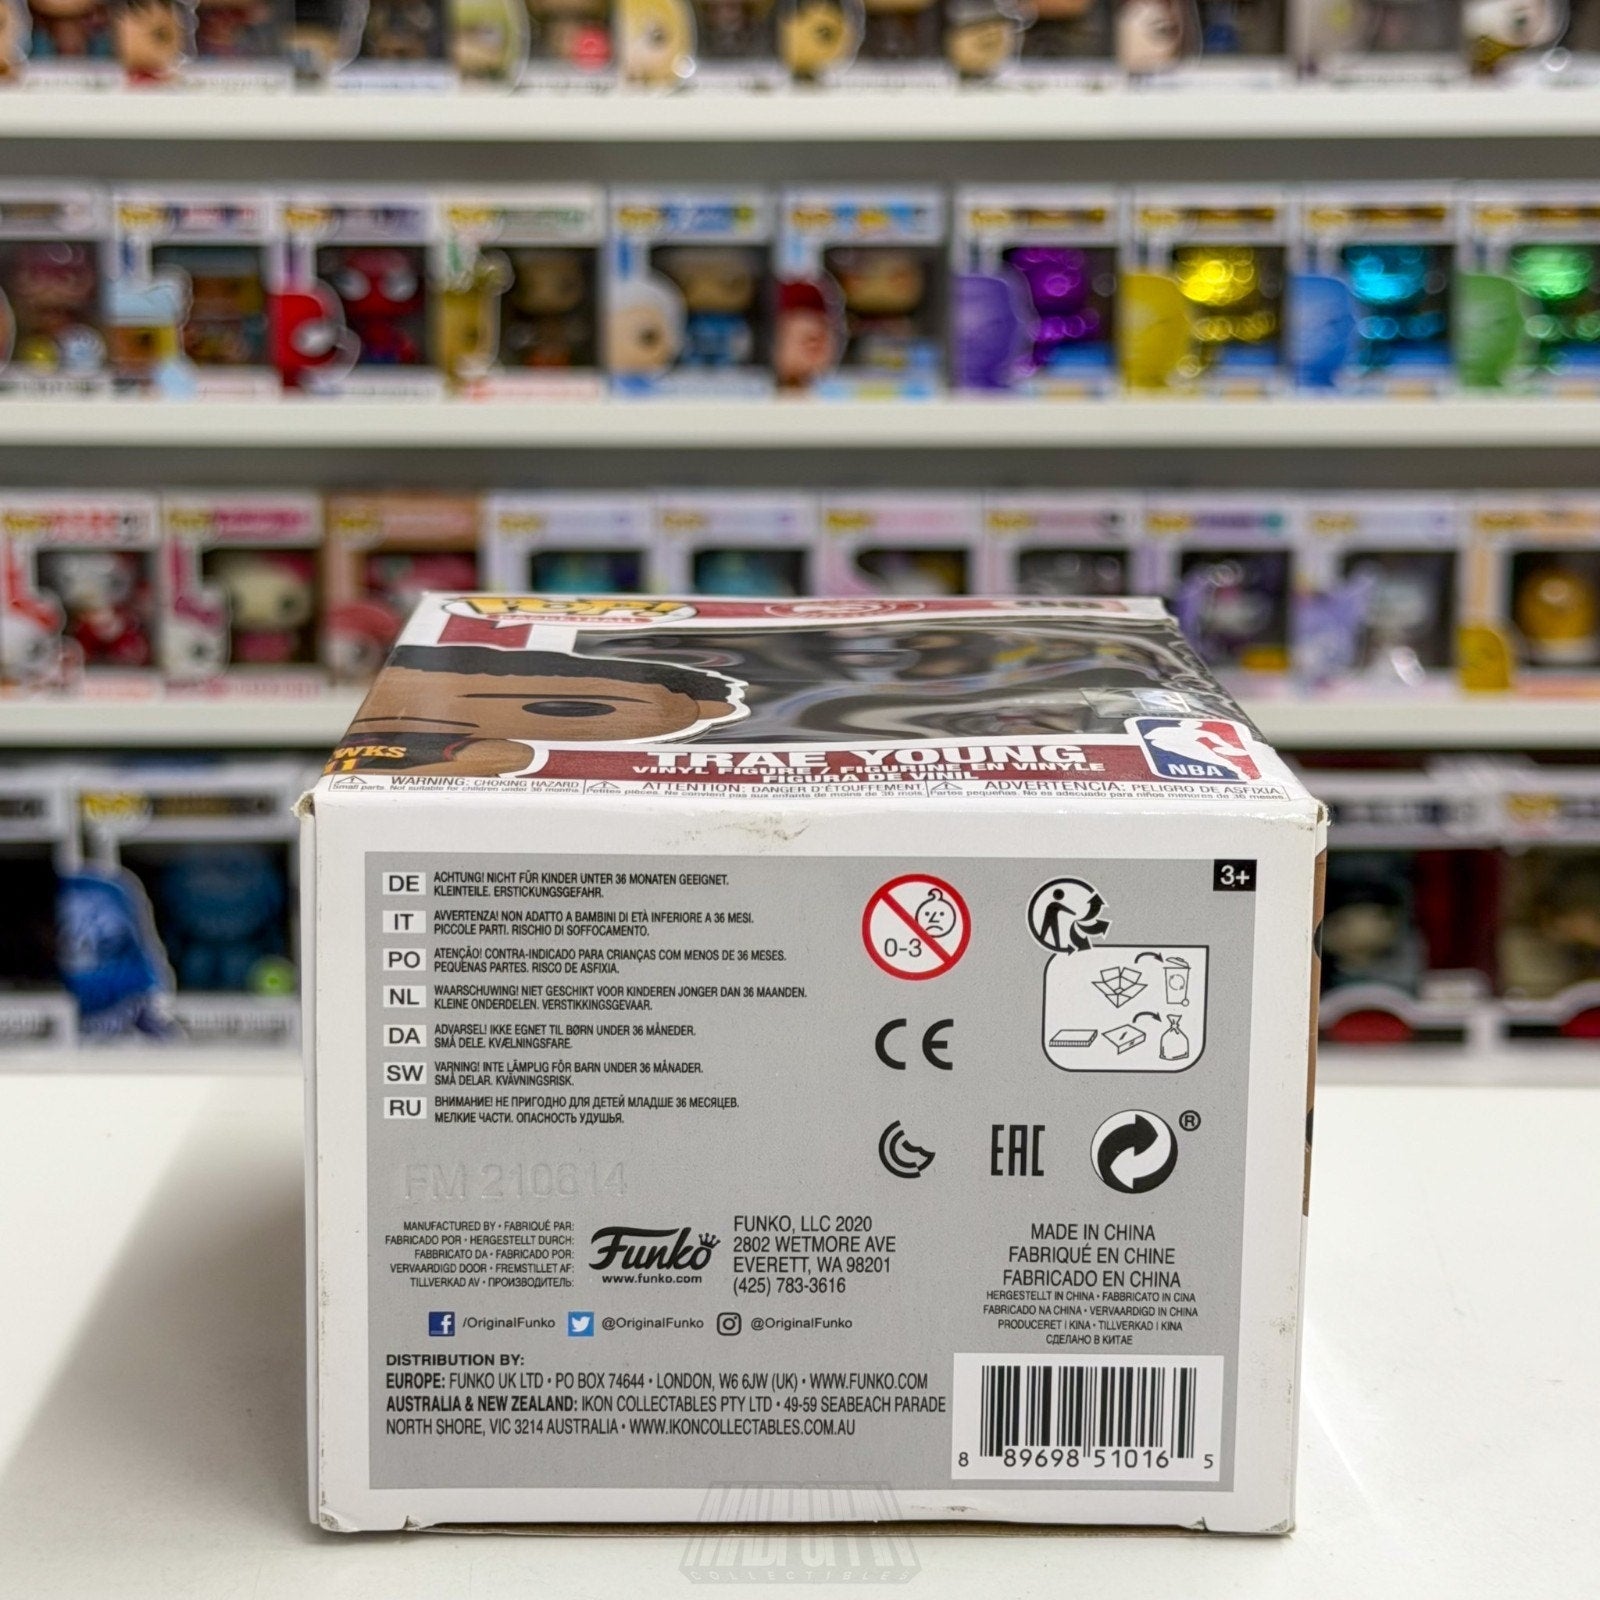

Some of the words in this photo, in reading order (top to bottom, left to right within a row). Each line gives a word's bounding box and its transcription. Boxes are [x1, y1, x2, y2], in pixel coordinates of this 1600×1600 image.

[645, 752, 826, 767] TRAE
[850, 746, 1086, 766] YOUNG
[632, 766, 710, 774] VINYL
[717, 766, 814, 775] FIGURE
[840, 763, 968, 774] FIGURINE
[974, 762, 1014, 771] EN
[1019, 762, 1106, 771] VINYLE
[762, 774, 857, 783] FIGURA
[864, 773, 901, 782] DE
[910, 771, 979, 780] VINIL
[1168, 763, 1222, 777] NBA
[391, 776, 468, 786] WARNING:
[474, 779, 526, 788] CHOKING
[530, 780, 579, 789] HAZARD
[641, 781, 746, 793] ATTENTION:
[750, 785, 807, 794] DANGER
[810, 782, 926, 793] D'ÉTOUFFEMENT.
[984, 780, 1128, 792] ADVERTENCIA:
[1130, 784, 1194, 794] PELIGRO
[1198, 784, 1222, 794] DE
[1224, 786, 1282, 795] ASFIXIA.
[388, 875, 419, 892] DE
[433, 871, 484, 883] ACHTUNG!
[486, 872, 516, 883] NICHT
[518, 872, 538, 883] FÜR
[540, 872, 577, 884] KINDER
[579, 872, 613, 884] UNTER
[615, 873, 626, 884] 36
[628, 873, 676, 885] MONATEN
[678, 873, 728, 885] GEEIGNET.
[1220, 866, 1250, 885] 3+
[433, 886, 490, 897] KLEINTEILE.
[493, 886, 603, 898] ERSTICKUNGSGEFAHR.
[394, 913, 414, 930] IT
[433, 910, 498, 921] AVVERTENZA!
[500, 910, 522, 921] NON
[524, 910, 563, 922] ADATTO
[565, 910, 572, 922] A
[574, 910, 616, 922] BAMBINI
[618, 911, 628, 922] DI
[631, 909, 648, 922] ETÀ
[650, 911, 702, 923] INFERIORE
[704, 912, 712, 923] A
[713, 912, 725, 923] 36
[727, 911, 753, 923] MESI.
[433, 923, 476, 935] PICCOLE
[478, 924, 509, 935] PARTI.
[511, 924, 552, 935] RISCHIO
[554, 924, 564, 935] DI
[566, 924, 649, 936] SOFFOCAMENTO.
[884, 939, 923, 958] 0-3
[388, 951, 420, 968] PO
[389, 988, 419, 1005] NL
[388, 1027, 420, 1044] DA
[386, 1064, 423, 1081] SW
[389, 1099, 421, 1116] RU
[434, 1095, 493, 1107] ВНИМАНИЕ!
[495, 1095, 509, 1107] НЕ
[511, 1095, 566, 1109] ПРИГОДНО
[568, 1096, 590, 1109] ДЛЯ
[591, 1096, 625, 1109] ДЕТЕЙ
[627, 1096, 673, 1109] МЛАДШЕ
[675, 1096, 687, 1108] 36
[688, 1096, 739, 1109] МЕСЯЦЕВ.
[434, 1111, 476, 1123] МЕЛКИЕ
[478, 1111, 513, 1123] ЧАСТИ.
[515, 1111, 577, 1124] ОПАСНОСТЬ
[579, 1112, 624, 1125] УДУШЬЯ.
[990, 1124, 1046, 1176] EAC
[403, 1220, 481, 1232] MANUFACTURED
[483, 1220, 496, 1231] BY
[503, 1218, 551, 1231] FABRIQUÉ
[553, 1220, 574, 1231] PAR:
[733, 1214, 795, 1234] FUNKO,
[800, 1214, 830, 1232] LLC
[834, 1215, 872, 1232] 2020
[1030, 1223, 1078, 1240] MADE
[1083, 1223, 1099, 1240] IN
[1104, 1224, 1155, 1241] CHINA
[588, 1226, 715, 1271] Funko
[732, 1235, 770, 1252] 2802
[774, 1235, 860, 1252] WETMORE
[864, 1235, 896, 1252] AVE
[1008, 1246, 1091, 1264] FABRIQUÉ
[1096, 1246, 1119, 1264] EN
[1123, 1247, 1175, 1264] CHINE
[733, 1255, 811, 1275] EVERETT,
[816, 1256, 843, 1272] WA
[846, 1256, 889, 1273] 98201
[601, 1274, 702, 1283] www.funko.com
[733, 1276, 771, 1296] (425)
[776, 1276, 846, 1293] 783-3616
[1003, 1269, 1097, 1287] FABRICADO
[1102, 1270, 1124, 1287] EN
[1129, 1270, 1181, 1288] CHINA
[986, 1290, 1052, 1300] HERGESTELLT
[1054, 1290, 1064, 1301] IN
[1065, 1290, 1095, 1301] CHINA
[1101, 1291, 1160, 1302] FABBRICATO
[1161, 1292, 1171, 1302] IN
[1173, 1292, 1196, 1302] CINA
[462, 1316, 555, 1330] /OriginalFunko
[601, 1316, 704, 1331] @OriginalFunko
[750, 1316, 852, 1331] @OriginalFunko
[1045, 1334, 1091, 1345] СДЕЛАНО
[1093, 1334, 1100, 1344] В
[1102, 1334, 1132, 1345] КИТАЕ
[386, 1353, 494, 1366] DISTRIBUTION
[499, 1353, 524, 1366] BY:
[385, 1372, 445, 1389] EUROPE:
[449, 1372, 495, 1389] FUNKO
[498, 1372, 516, 1389] UK
[520, 1372, 543, 1388] LTD
[555, 1372, 574, 1389] PO
[577, 1372, 605, 1389] BOX
[608, 1372, 644, 1389] 74644
[656, 1372, 714, 1390] LONDON,
[718, 1373, 738, 1389] W6
[741, 1373, 768, 1389] 6JW
[771, 1373, 798, 1390] (UK)
[809, 1373, 927, 1390] WWW.FUNKO.COM
[386, 1396, 462, 1412] AUSTRALIA
[464, 1396, 474, 1412] &
[477, 1396, 508, 1411] NEW
[510, 1396, 577, 1411] ZEALAND:
[581, 1396, 612, 1412] IKON
[616, 1396, 716, 1412] COLLECTABLES
[720, 1396, 745, 1412] PTY
[749, 1396, 772, 1412] LTD
[783, 1396, 817, 1412] 49-59
[820, 1396, 890, 1412] SEABEACH
[894, 1396, 946, 1412] PARADE
[386, 1418, 432, 1435] NORTH
[435, 1418, 485, 1436] SHORE,
[489, 1418, 511, 1434] VIC
[514, 1418, 543, 1434] 3214
[546, 1418, 618, 1434] AUSTRALIA
[629, 1418, 855, 1435] WWW.IKONCOLLECTABLES.COM.AU
[958, 1452, 970, 1467] 8
[1003, 1448, 1080, 1468] 89698
[1094, 1450, 1169, 1468] 51016
[1203, 1454, 1214, 1469] 5
